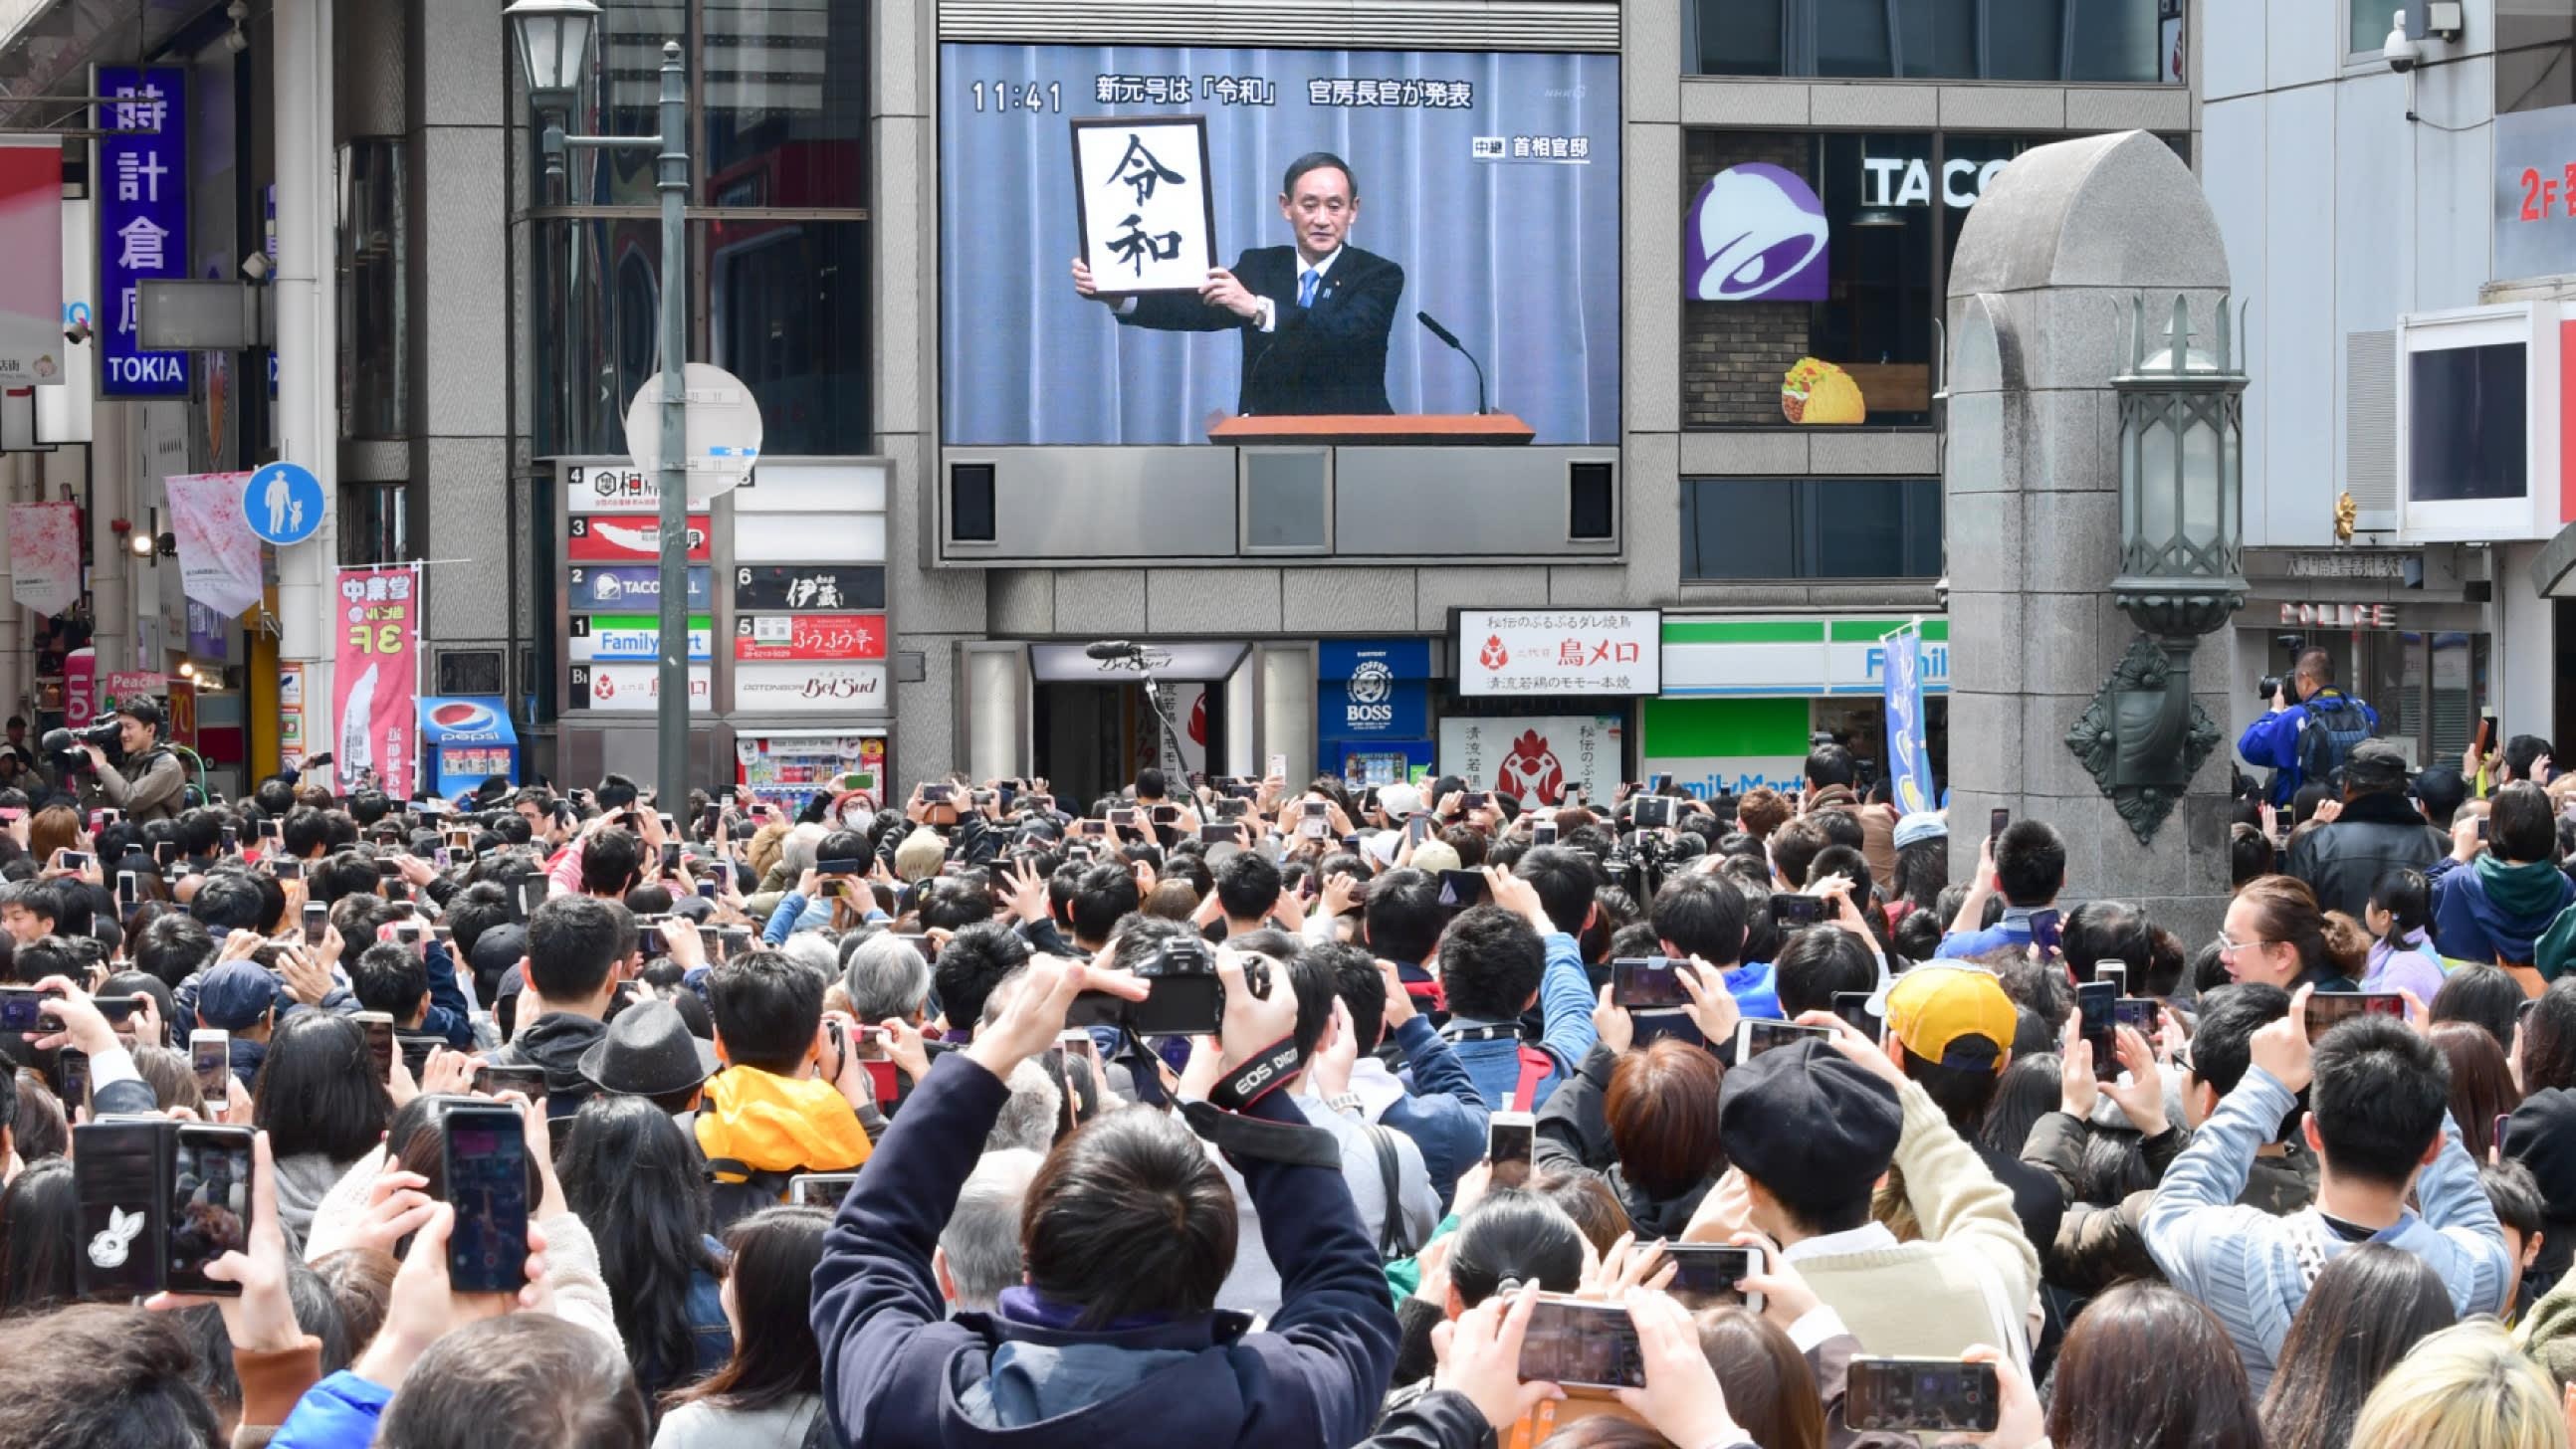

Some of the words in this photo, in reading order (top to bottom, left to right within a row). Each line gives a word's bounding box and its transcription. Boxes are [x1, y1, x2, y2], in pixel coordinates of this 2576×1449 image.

[971, 81, 1061, 112] 11:41
[1096, 76, 1275, 105] 新元号は「令和」
[1308, 79, 1473, 108] 官房長官が発表
[1513, 135, 1589, 158] 首相官邸
[1106, 133, 1185, 278] 令和
[108, 357, 183, 382] TOKIA
[570, 469, 581, 483] 4
[572, 519, 584, 535] 3
[571, 568, 582, 582] 2
[738, 567, 751, 585] 6
[575, 618, 584, 635] 1
[739, 619, 751, 635] 5
[2280, 602, 2397, 629] POLICE
[1558, 637, 1639, 667] 鳥メロ
[1346, 705, 1393, 721] BOSS
[1235, 1062, 1273, 1096] EOS
